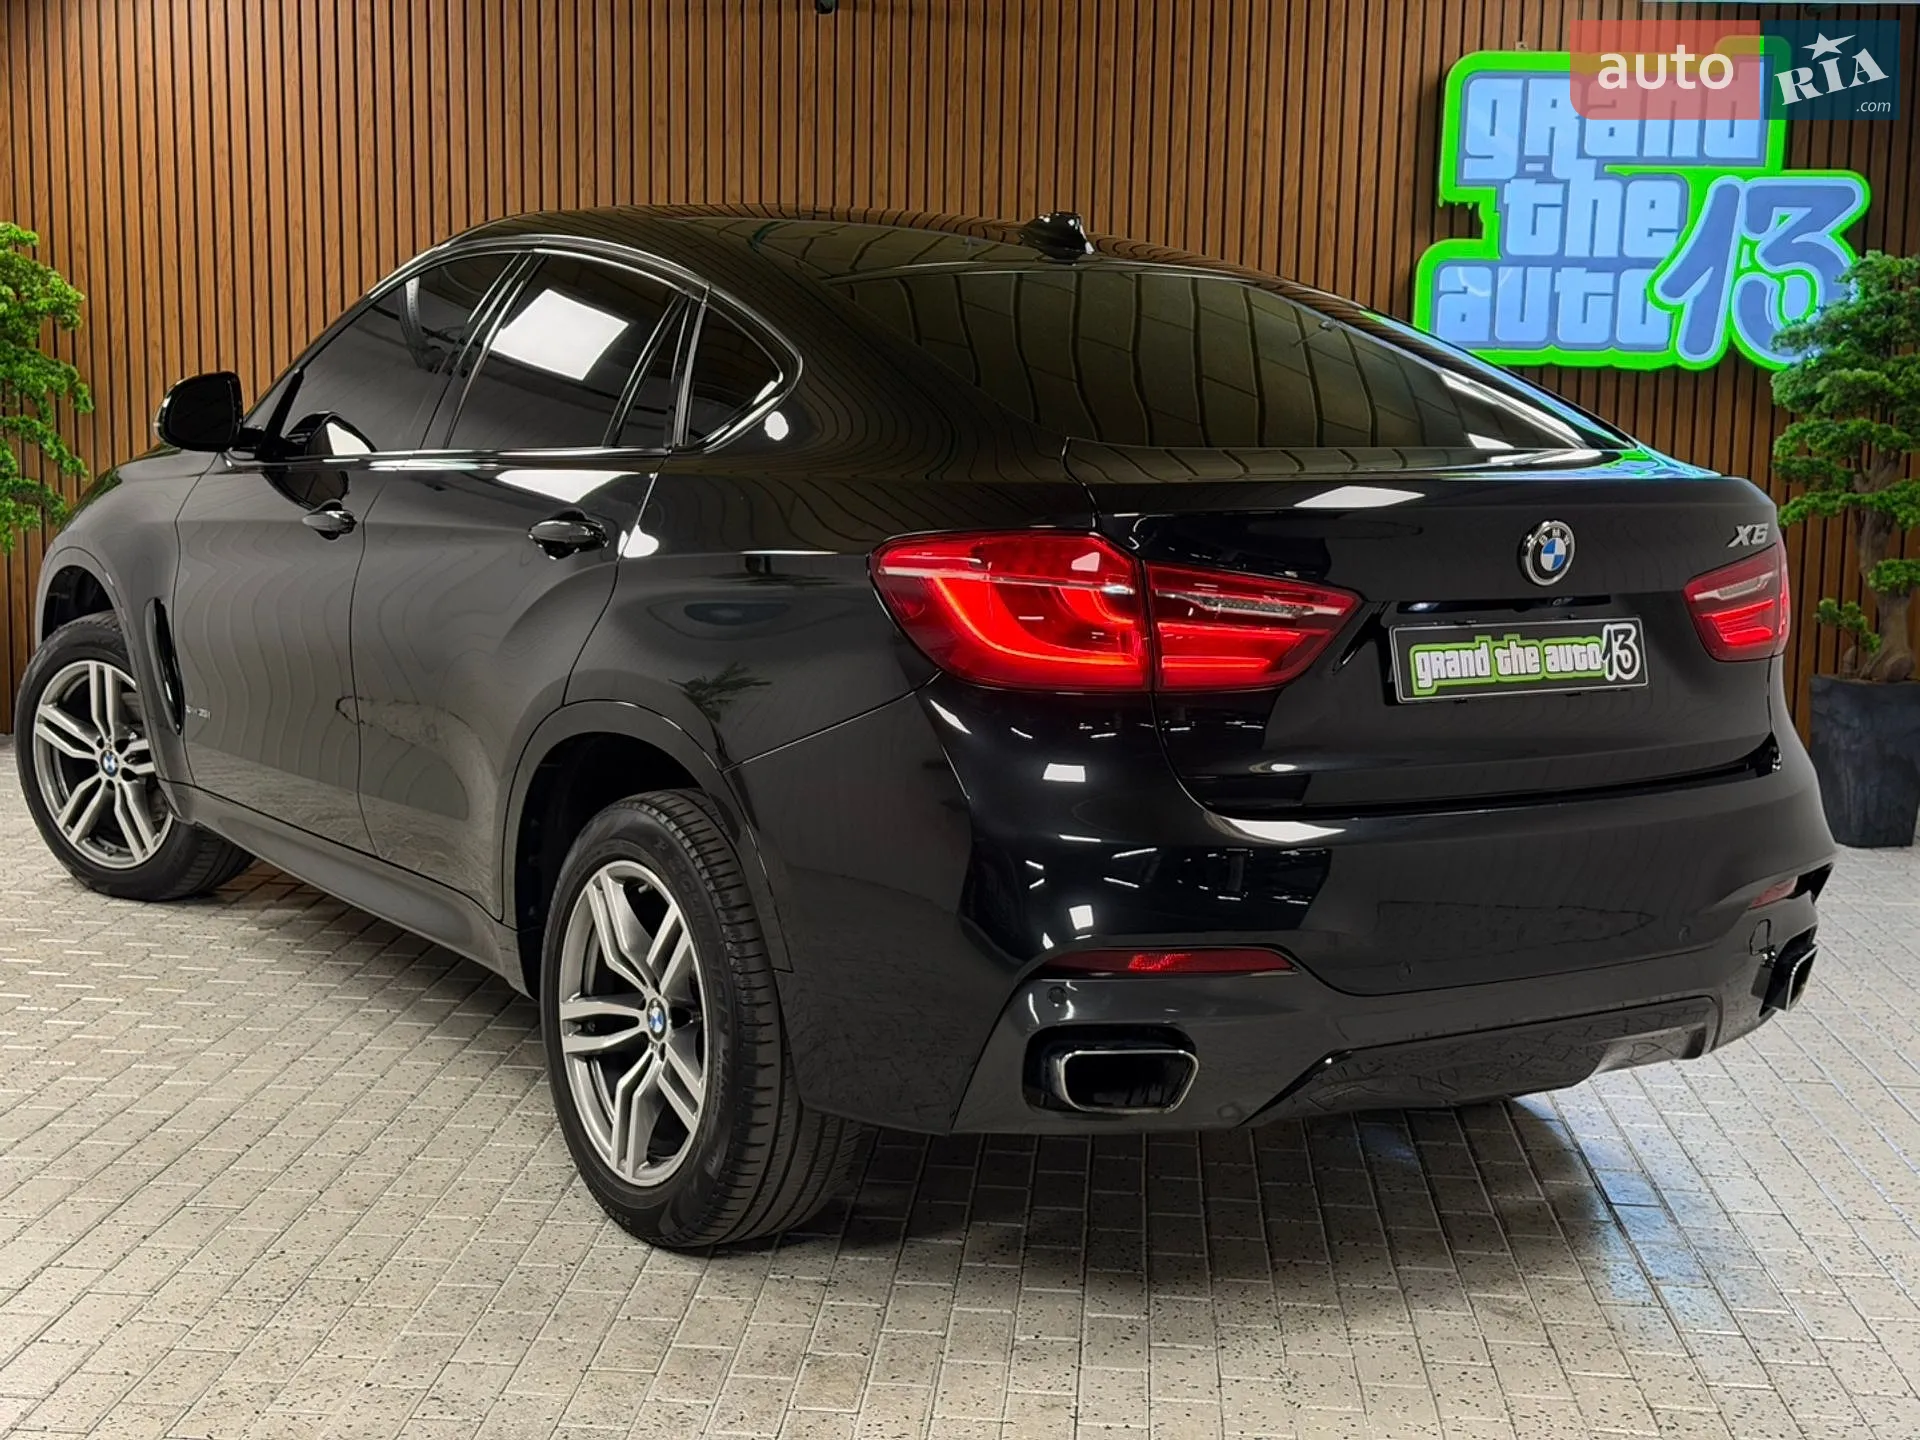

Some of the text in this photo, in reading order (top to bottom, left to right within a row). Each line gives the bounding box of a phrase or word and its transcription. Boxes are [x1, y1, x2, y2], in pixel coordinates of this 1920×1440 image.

[1504, 158, 1685, 258] the
[1437, 176, 1864, 363] auto 13
[1727, 523, 1769, 548] X6
[1494, 640, 1541, 675] the
[1544, 643, 1602, 673] auto
[1600, 623, 1641, 681] 13
